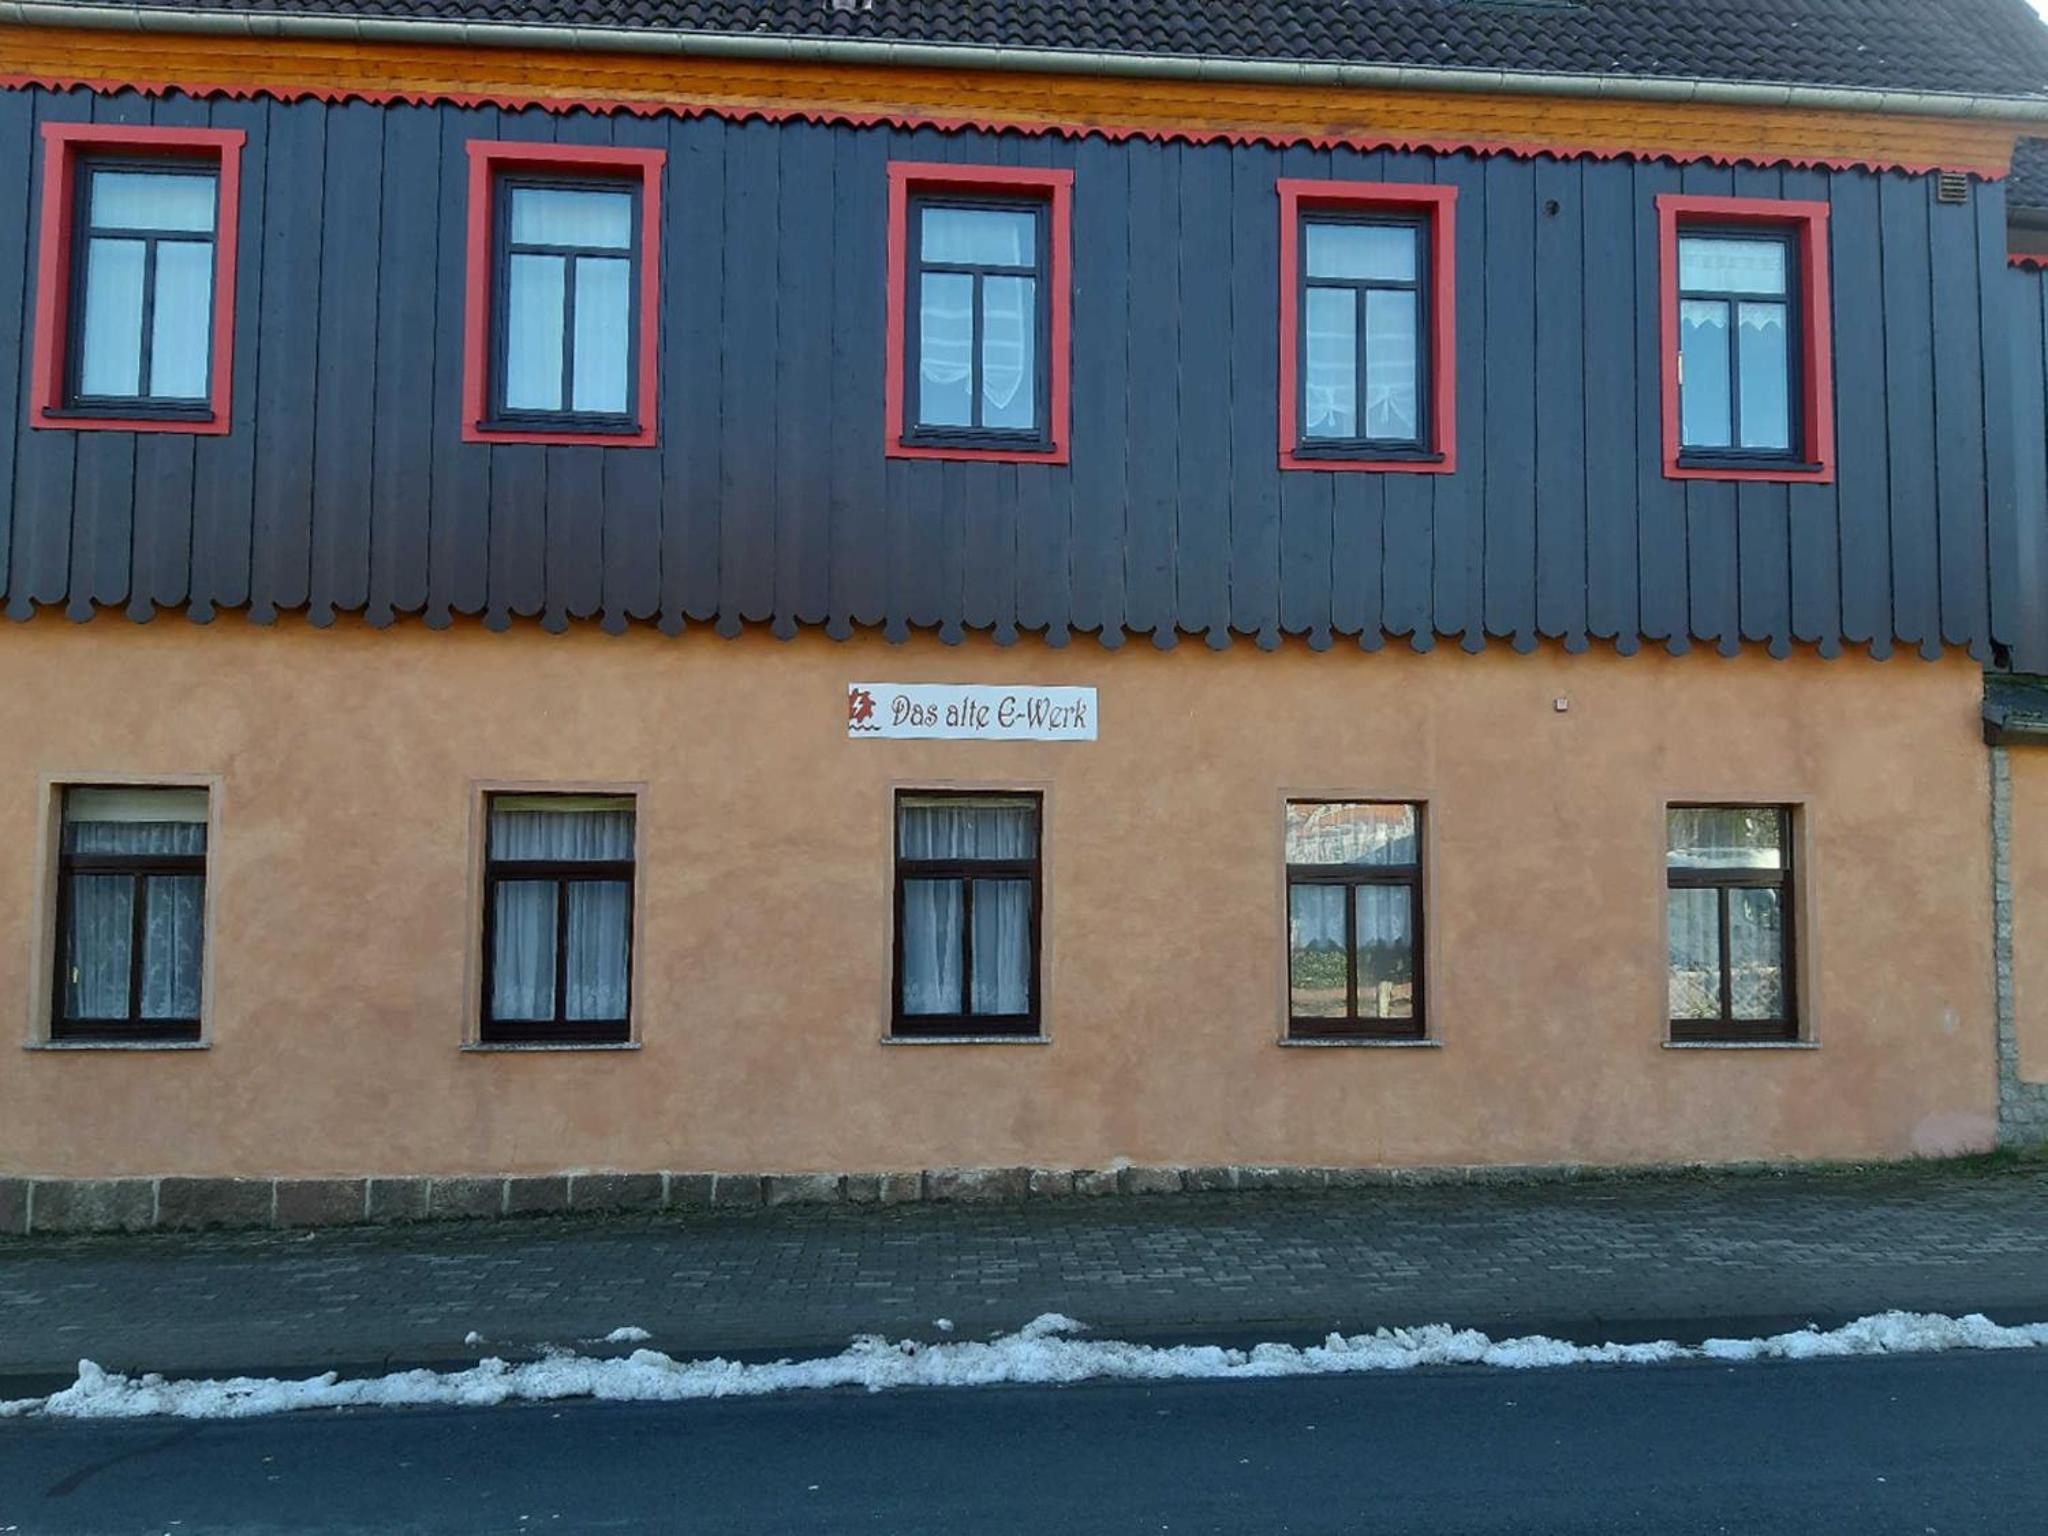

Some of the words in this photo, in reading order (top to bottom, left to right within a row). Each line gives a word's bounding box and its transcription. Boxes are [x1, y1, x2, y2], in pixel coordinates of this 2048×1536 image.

[891, 694, 938, 727] Das
[946, 696, 990, 730] alte
[997, 695, 1087, 731] E-Werk
